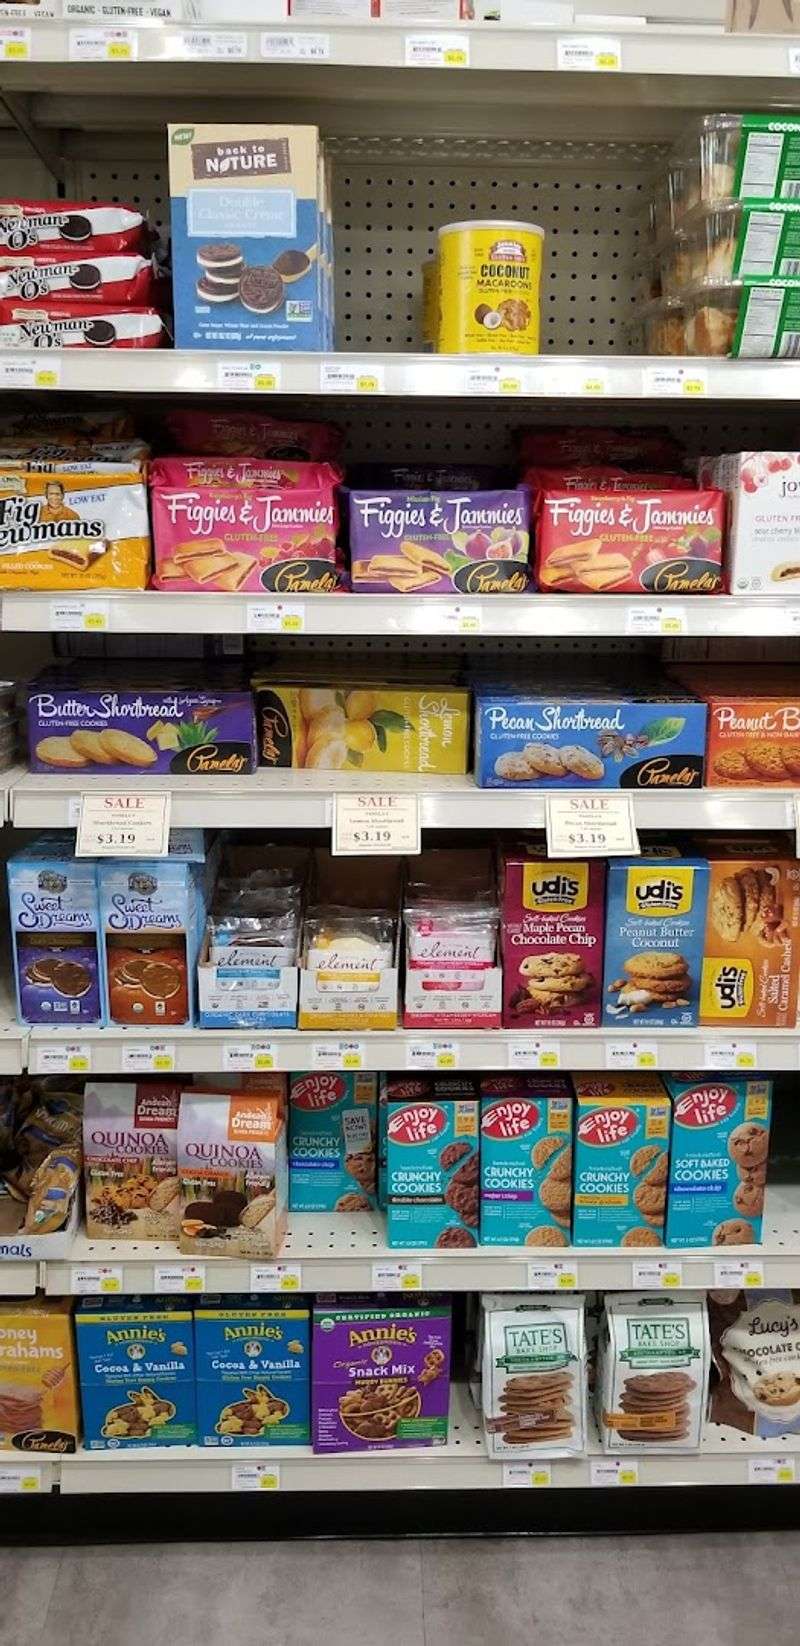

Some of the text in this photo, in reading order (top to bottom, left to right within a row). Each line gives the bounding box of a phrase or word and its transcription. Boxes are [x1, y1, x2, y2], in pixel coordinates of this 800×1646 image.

[67, 5, 171, 17] ORGANIC GLUTEN-FREE VEGAN
[217, 145, 265, 156] back to
[8, 229, 37, 249] O's
[480, 264, 531, 279] COCONUT
[20, 277, 49, 299] O's
[477, 279, 532, 290] MACAROONS
[183, 461, 281, 484] Figgies & Jammies
[69, 493, 107, 506] LOW FAT
[0, 497, 39, 525] Fig
[160, 492, 334, 535] Figgies & Jammies
[353, 497, 523, 538] Figgies & Jammies
[544, 497, 714, 536] Figgies & Jammies
[755, 515, 788, 523] GLUTEN
[29, 693, 95, 718] Butter
[94, 693, 184, 718] Shortbread
[485, 706, 625, 732] Pecan Shortbread
[713, 706, 777, 731] Peanut
[490, 732, 560, 741] GLUTEN-FREE COOKIES
[187, 744, 249, 773] Pamela's
[637, 757, 699, 787] Pamela's
[102, 797, 145, 809] SALE
[357, 796, 399, 808] SALE
[569, 799, 610, 811] SALE
[97, 833, 136, 846] $3.19
[353, 831, 392, 843] $3.19
[568, 833, 607, 846] $3.19
[531, 875, 580, 896] udi's
[635, 880, 684, 901] udi's
[21, 892, 72, 914] Sweet
[111, 892, 163, 914] Sweet
[18, 911, 92, 929] Dreams
[108, 911, 182, 930] Dreams
[523, 923, 586, 934] Maple Pecan
[511, 934, 597, 947] Chocolate Chip
[619, 927, 694, 938] Peanut Butter
[417, 942, 480, 960] element
[631, 937, 680, 948] Coconut
[217, 950, 278, 968] element
[318, 953, 380, 970] element
[715, 966, 738, 1009] udi's
[290, 1072, 338, 1100] Enjoy
[307, 1089, 338, 1108] life
[674, 1087, 728, 1116] Enjoy
[137, 1105, 177, 1117] Dream
[345, 1114, 366, 1125] SAVE
[388, 1106, 439, 1133] Enjoy
[481, 1102, 532, 1129] Enjoy
[694, 1104, 727, 1124] life
[231, 1117, 272, 1130] Dream
[405, 1121, 438, 1142] life
[499, 1117, 530, 1137] life
[578, 1110, 630, 1136] Enjoy
[91, 1131, 168, 1148] QUINOA
[292, 1137, 340, 1146] CRUNCHY
[596, 1124, 629, 1143] life
[116, 1145, 169, 1155] COOKIES
[185, 1143, 262, 1161] QUINOA
[292, 1147, 341, 1159] COOKIES
[209, 1157, 263, 1169] COOKIES
[675, 1158, 730, 1169] SOFT BAKED
[90, 1168, 124, 1178] Gluten Free
[391, 1171, 441, 1182] CRUNCHY
[484, 1167, 535, 1178] CRUNCHY
[579, 1172, 630, 1183] CRUNCHY
[674, 1168, 729, 1181] COOKIES
[183, 1178, 201, 1187] Gluten
[391, 1182, 442, 1193] COOKIES
[484, 1178, 535, 1189] COOKIES
[579, 1182, 630, 1194] COOKIES
[335, 1313, 387, 1321] CERTIFIED
[106, 1325, 167, 1344] Annie's
[223, 1322, 284, 1341] Annie's
[632, 1323, 686, 1341] TATE'S
[748, 1316, 799, 1337] Lucy's
[349, 1323, 418, 1348] Annie's
[509, 1327, 563, 1348] TATE'S
[95, 1361, 186, 1374] Cocoa & Vanilla
[211, 1359, 301, 1370] Cocoa & Vanilla
[348, 1364, 416, 1378] Snack Mix
